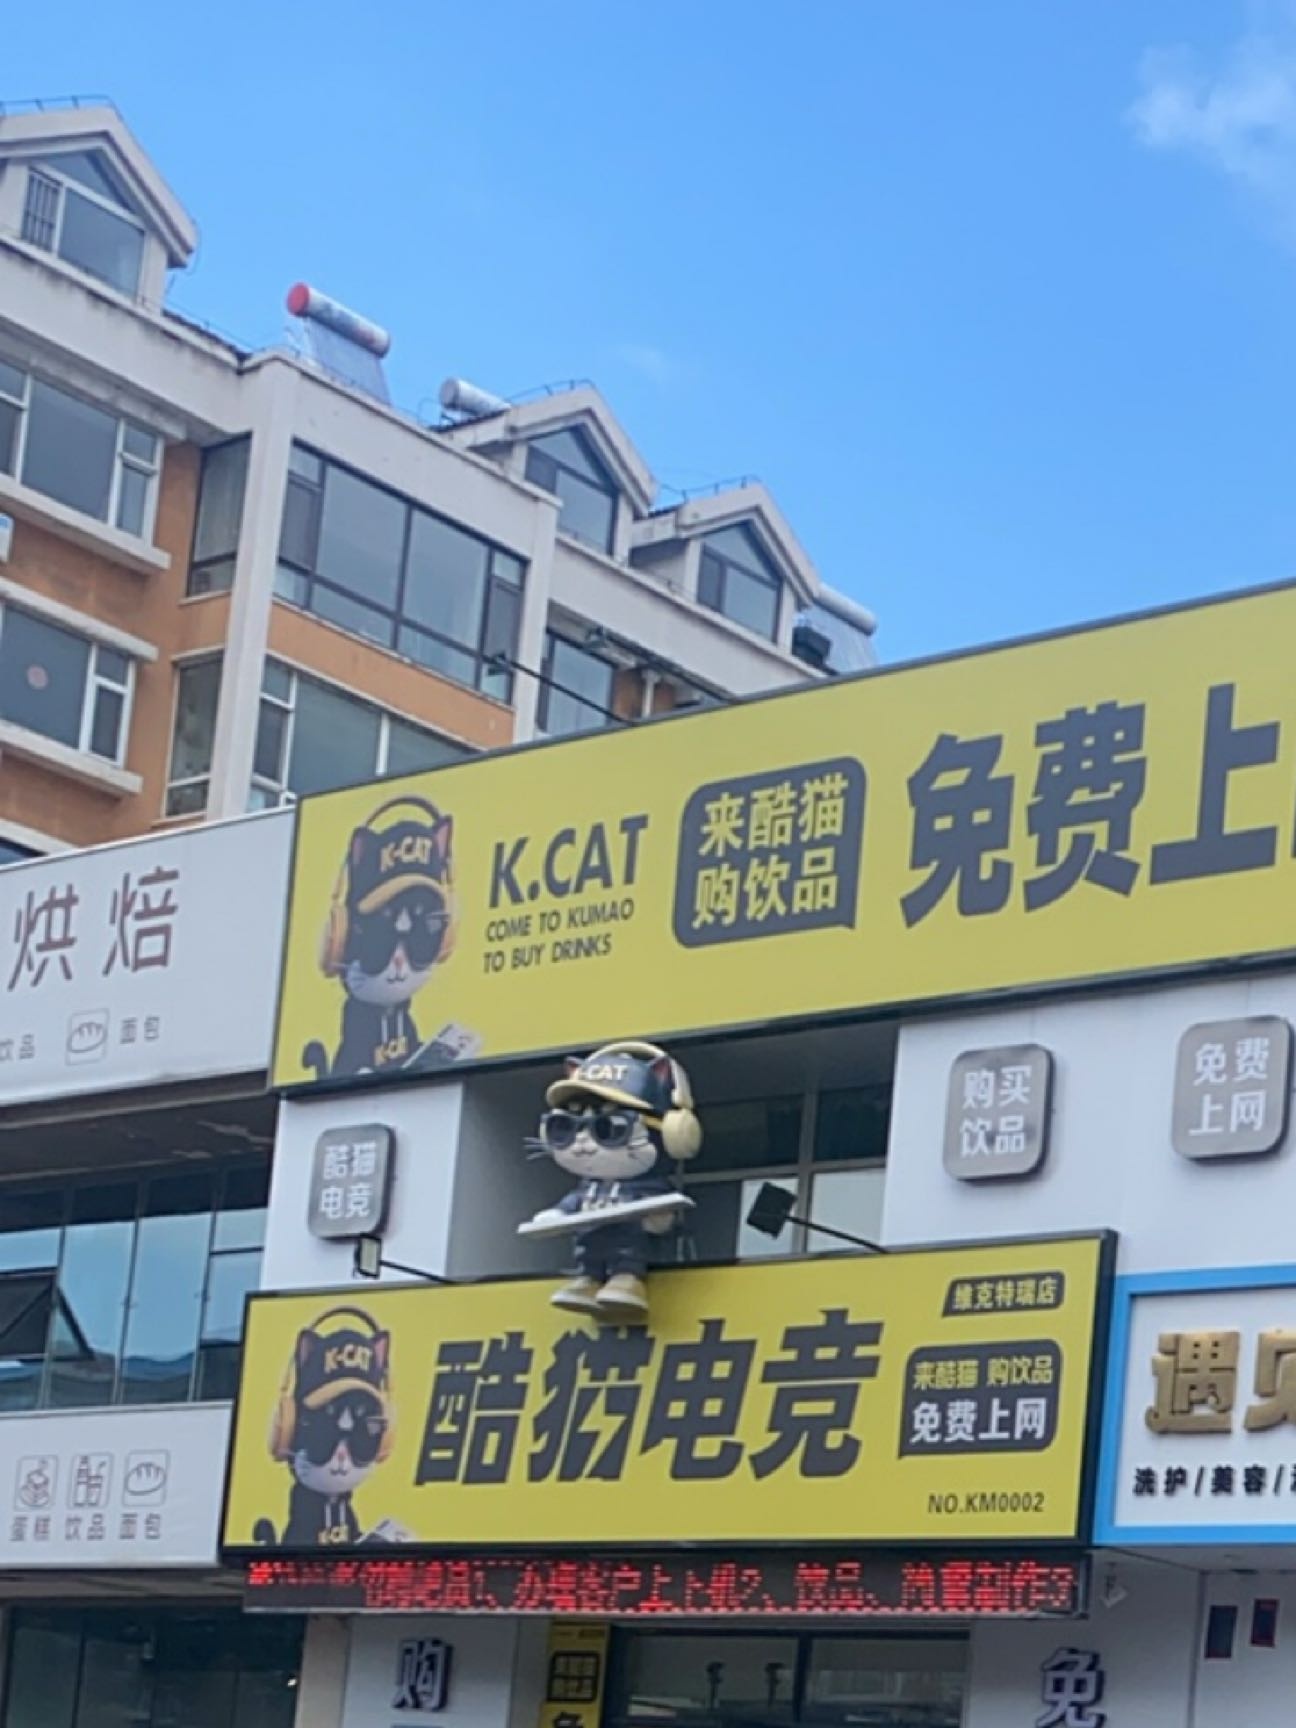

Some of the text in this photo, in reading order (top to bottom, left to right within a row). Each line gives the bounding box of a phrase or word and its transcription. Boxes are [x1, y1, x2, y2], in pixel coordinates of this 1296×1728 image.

[698, 772, 849, 858] 来酷猫
[489, 814, 649, 909] K.CAT
[692, 846, 838, 930] 购饮品
[7, 866, 179, 992] 烘焙
[486, 898, 634, 942] COME TO KUMAO
[483, 933, 612, 973] TO BUY DRINKS
[1193, 1037, 1270, 1087] 免费
[962, 1064, 1032, 1110] 购买
[960, 1115, 1026, 1157] 饮品
[1189, 1089, 1267, 1137] 上网
[323, 1141, 377, 1180] 酷猫
[319, 1182, 373, 1220] 电竞
[952, 1276, 1057, 1311] 维克特瑞店
[913, 1355, 1053, 1391] 来酷猫 购饮品
[415, 1308, 884, 1485] 酷猫电竞
[909, 1397, 1047, 1443] 免费上网
[928, 1491, 1045, 1515] NO.KM0002
